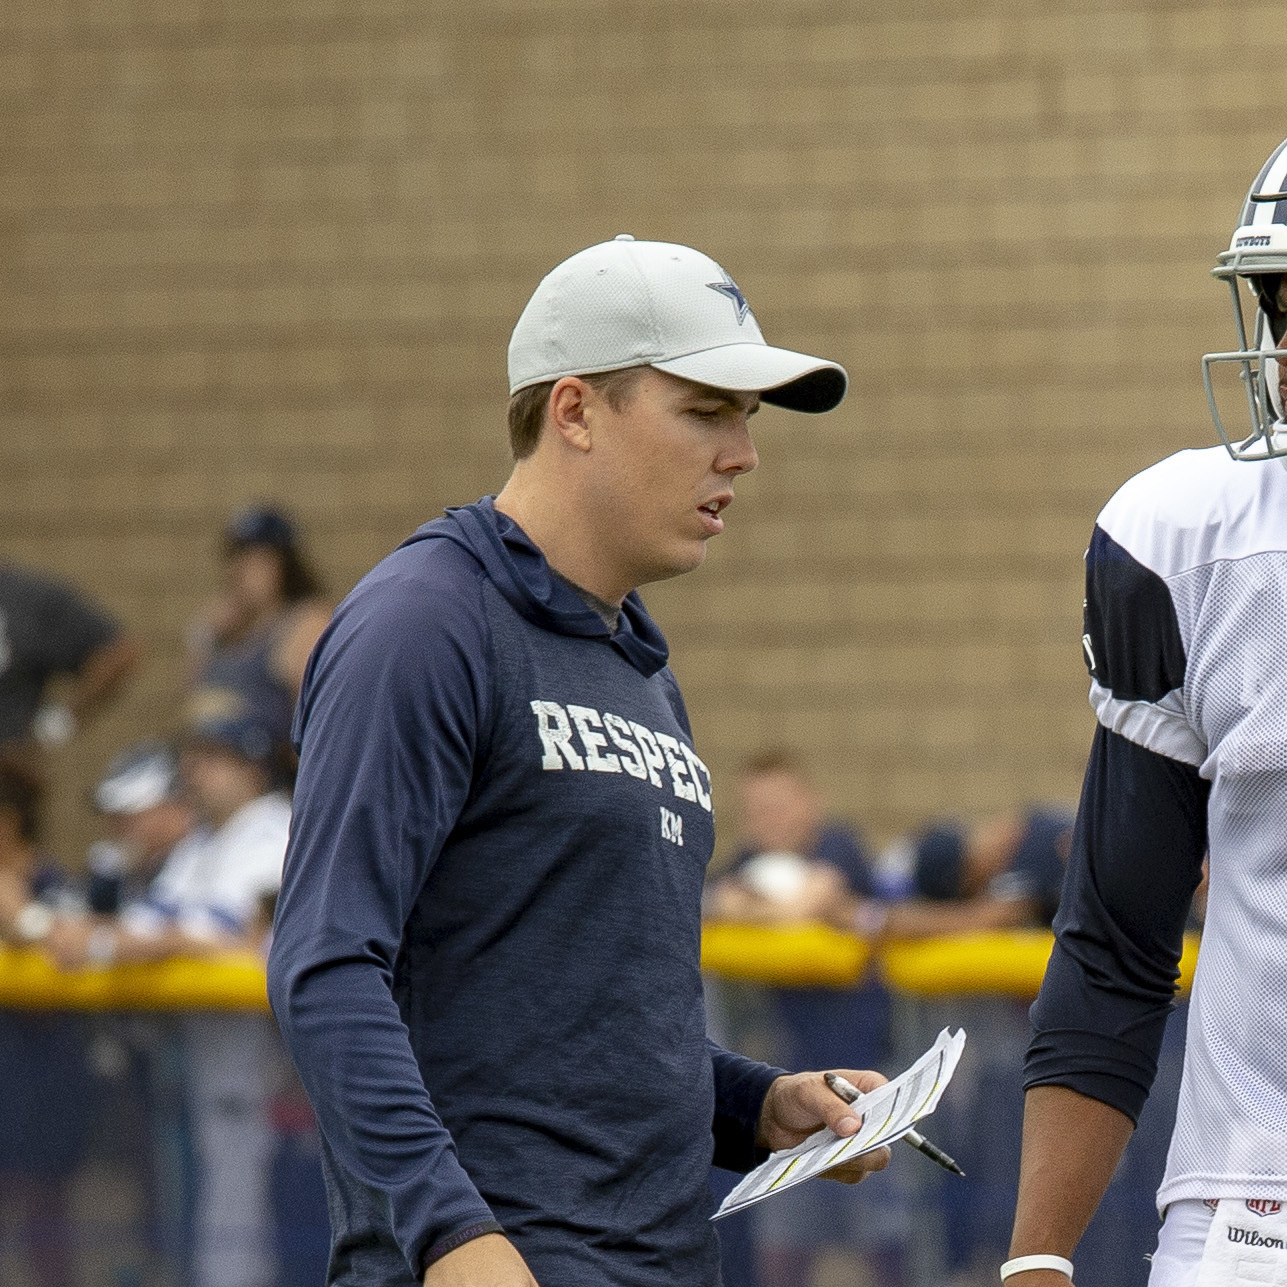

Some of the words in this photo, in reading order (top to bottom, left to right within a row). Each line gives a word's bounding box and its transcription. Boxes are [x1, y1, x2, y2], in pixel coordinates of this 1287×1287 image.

[530, 700, 714, 813] RESPEC
[659, 806, 684, 846] KM
[1227, 1225, 1285, 1250] Wilson
